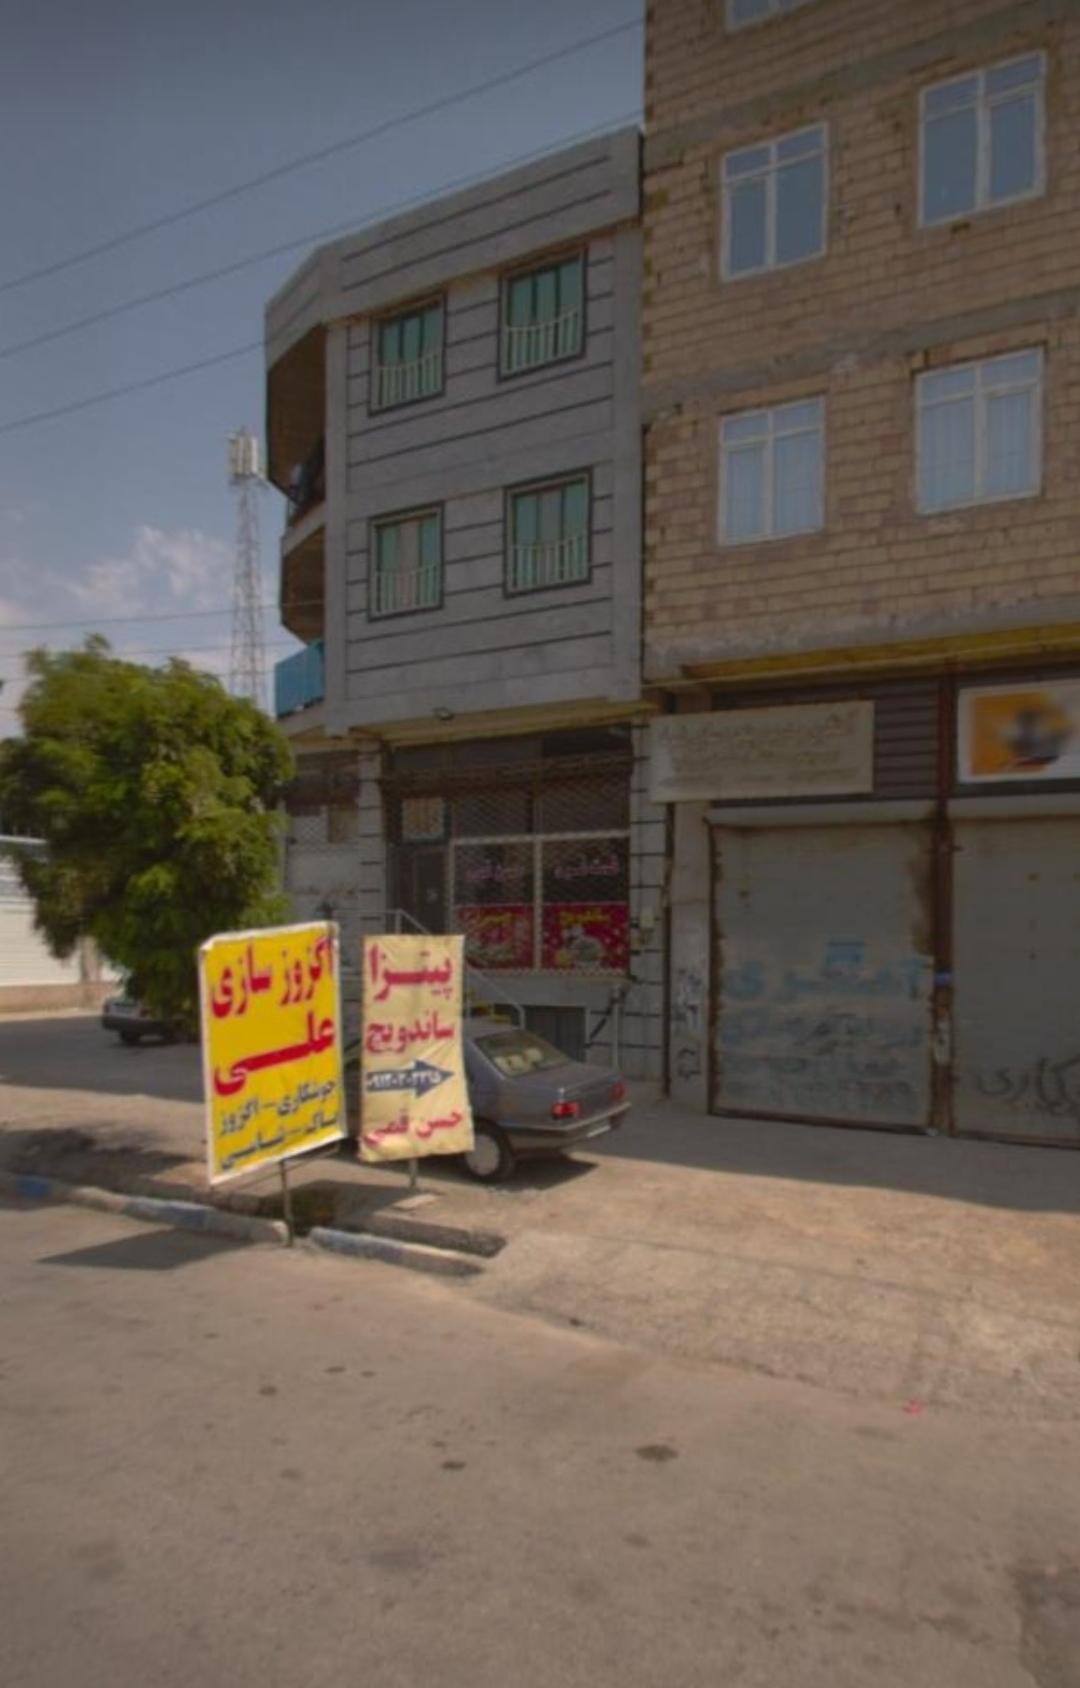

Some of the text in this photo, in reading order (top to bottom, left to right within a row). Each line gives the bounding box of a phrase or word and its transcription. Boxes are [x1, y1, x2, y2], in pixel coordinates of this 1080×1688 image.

[212, 936, 335, 1018] اگزوز سازی
[367, 943, 453, 1001] پیتزا
[213, 1012, 334, 1096] علی
[366, 1011, 454, 1053] ساندویچ
